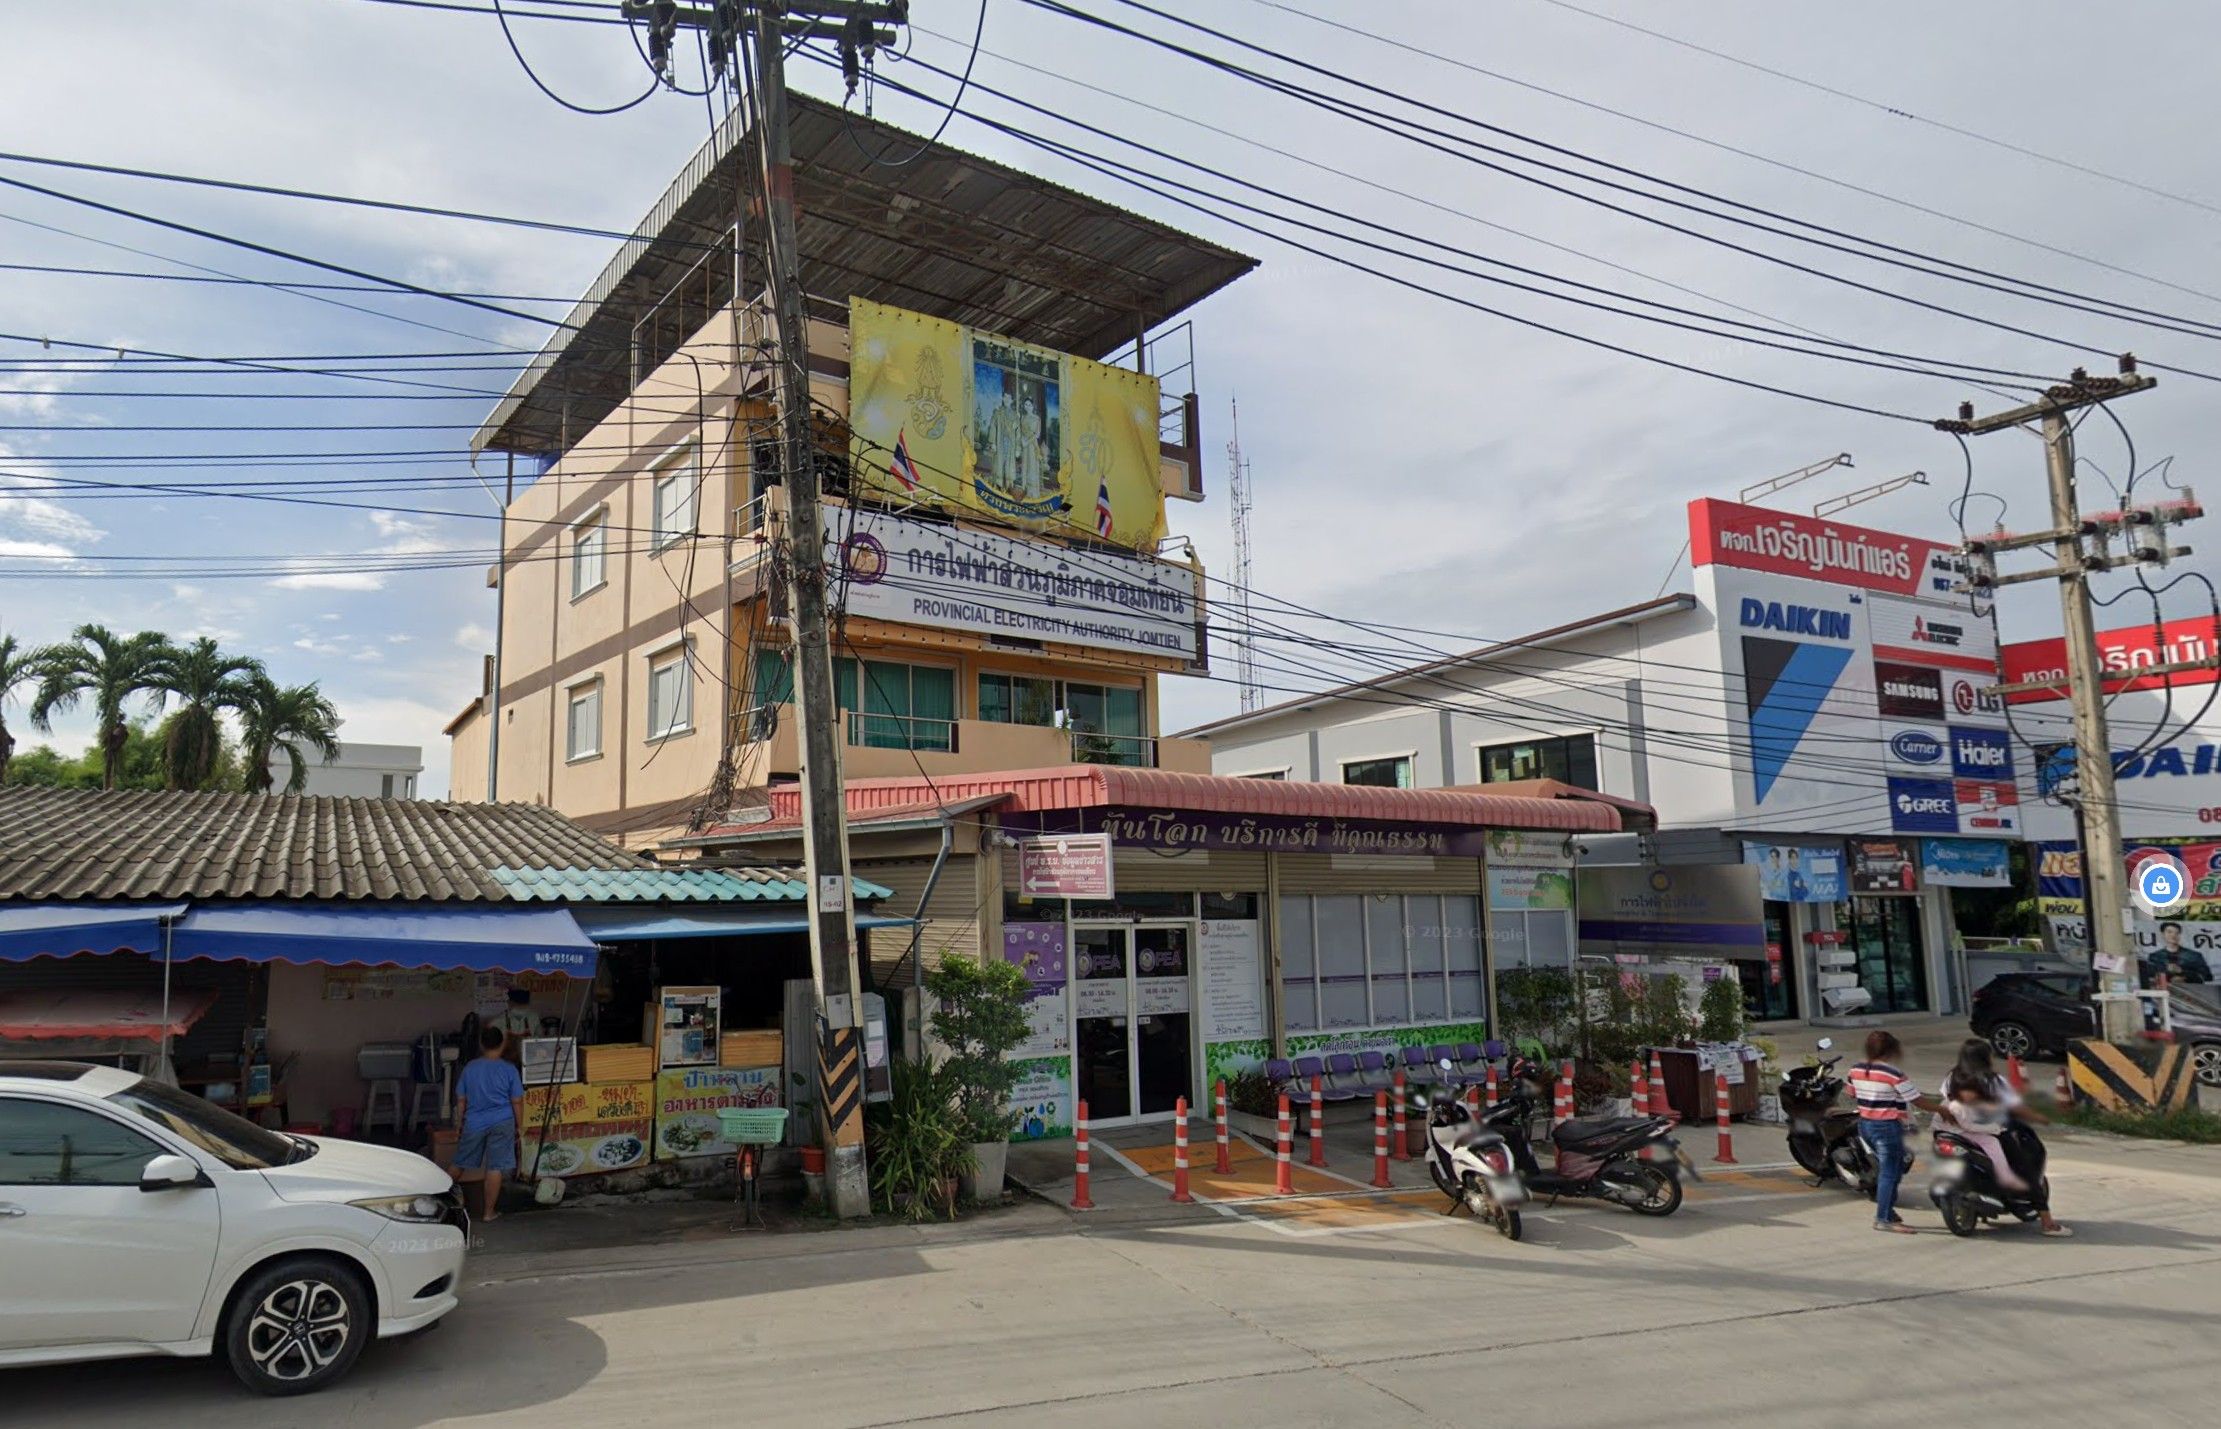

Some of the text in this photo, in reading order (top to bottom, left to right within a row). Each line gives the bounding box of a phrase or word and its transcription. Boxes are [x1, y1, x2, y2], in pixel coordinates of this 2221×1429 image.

[907, 540, 1185, 615] การไฟฟ้าส่วนภูมิภาคจอมเทียน
[913, 598, 1181, 649] PROVINCIAL ELECTRICITY AUTHORITY JOMTIEN
[1740, 597, 1851, 640] DAIKIN
[1883, 681, 1939, 701] SAMSUNG
[1958, 738, 2006, 766] Haier
[2110, 744, 2221, 779] DAI
[1101, 811, 1443, 853] ทันโลก บริการดี มีคุณธรรม
[1155, 951, 1182, 966] PEA
